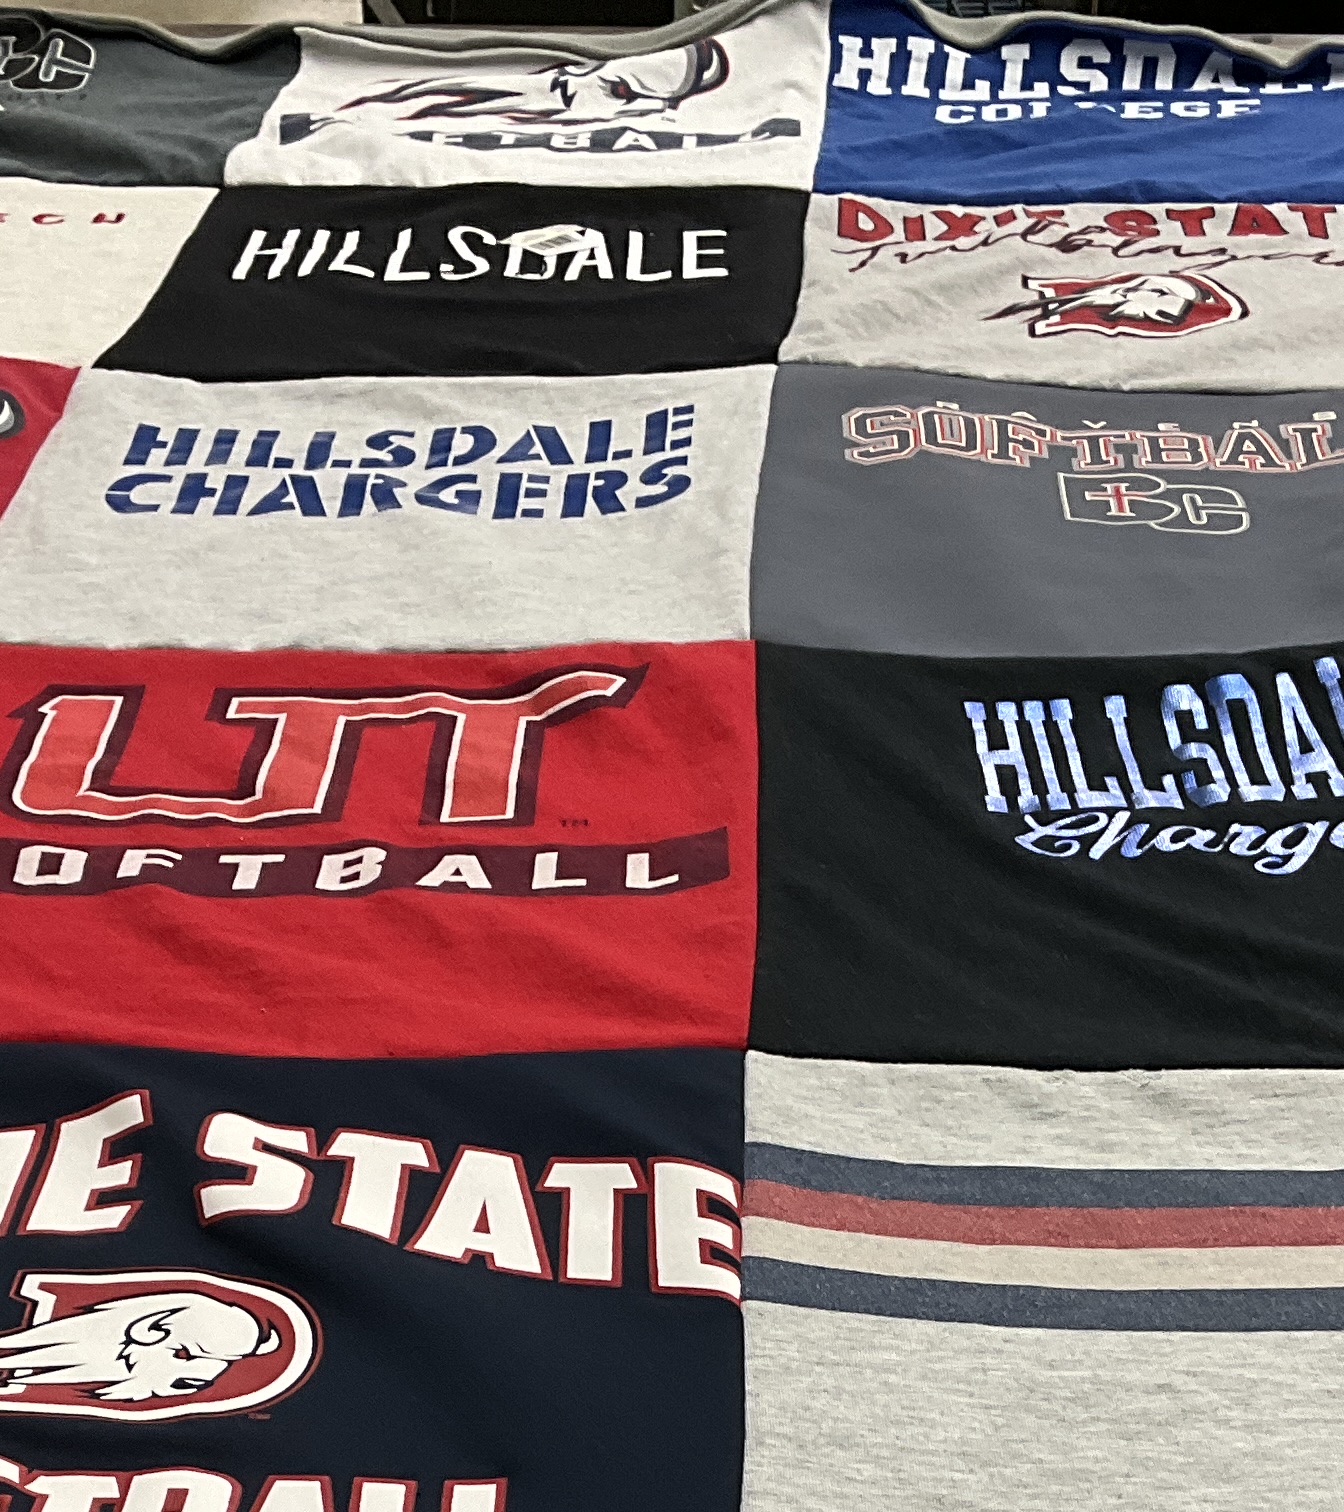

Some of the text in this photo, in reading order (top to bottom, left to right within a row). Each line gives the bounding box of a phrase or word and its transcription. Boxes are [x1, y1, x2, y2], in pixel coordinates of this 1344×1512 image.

[231, 224, 730, 282] HILLSDALE
[122, 404, 695, 470] HILLSDALE
[104, 455, 694, 520] CHARGERS
[195, 1110, 744, 1307] STATE
